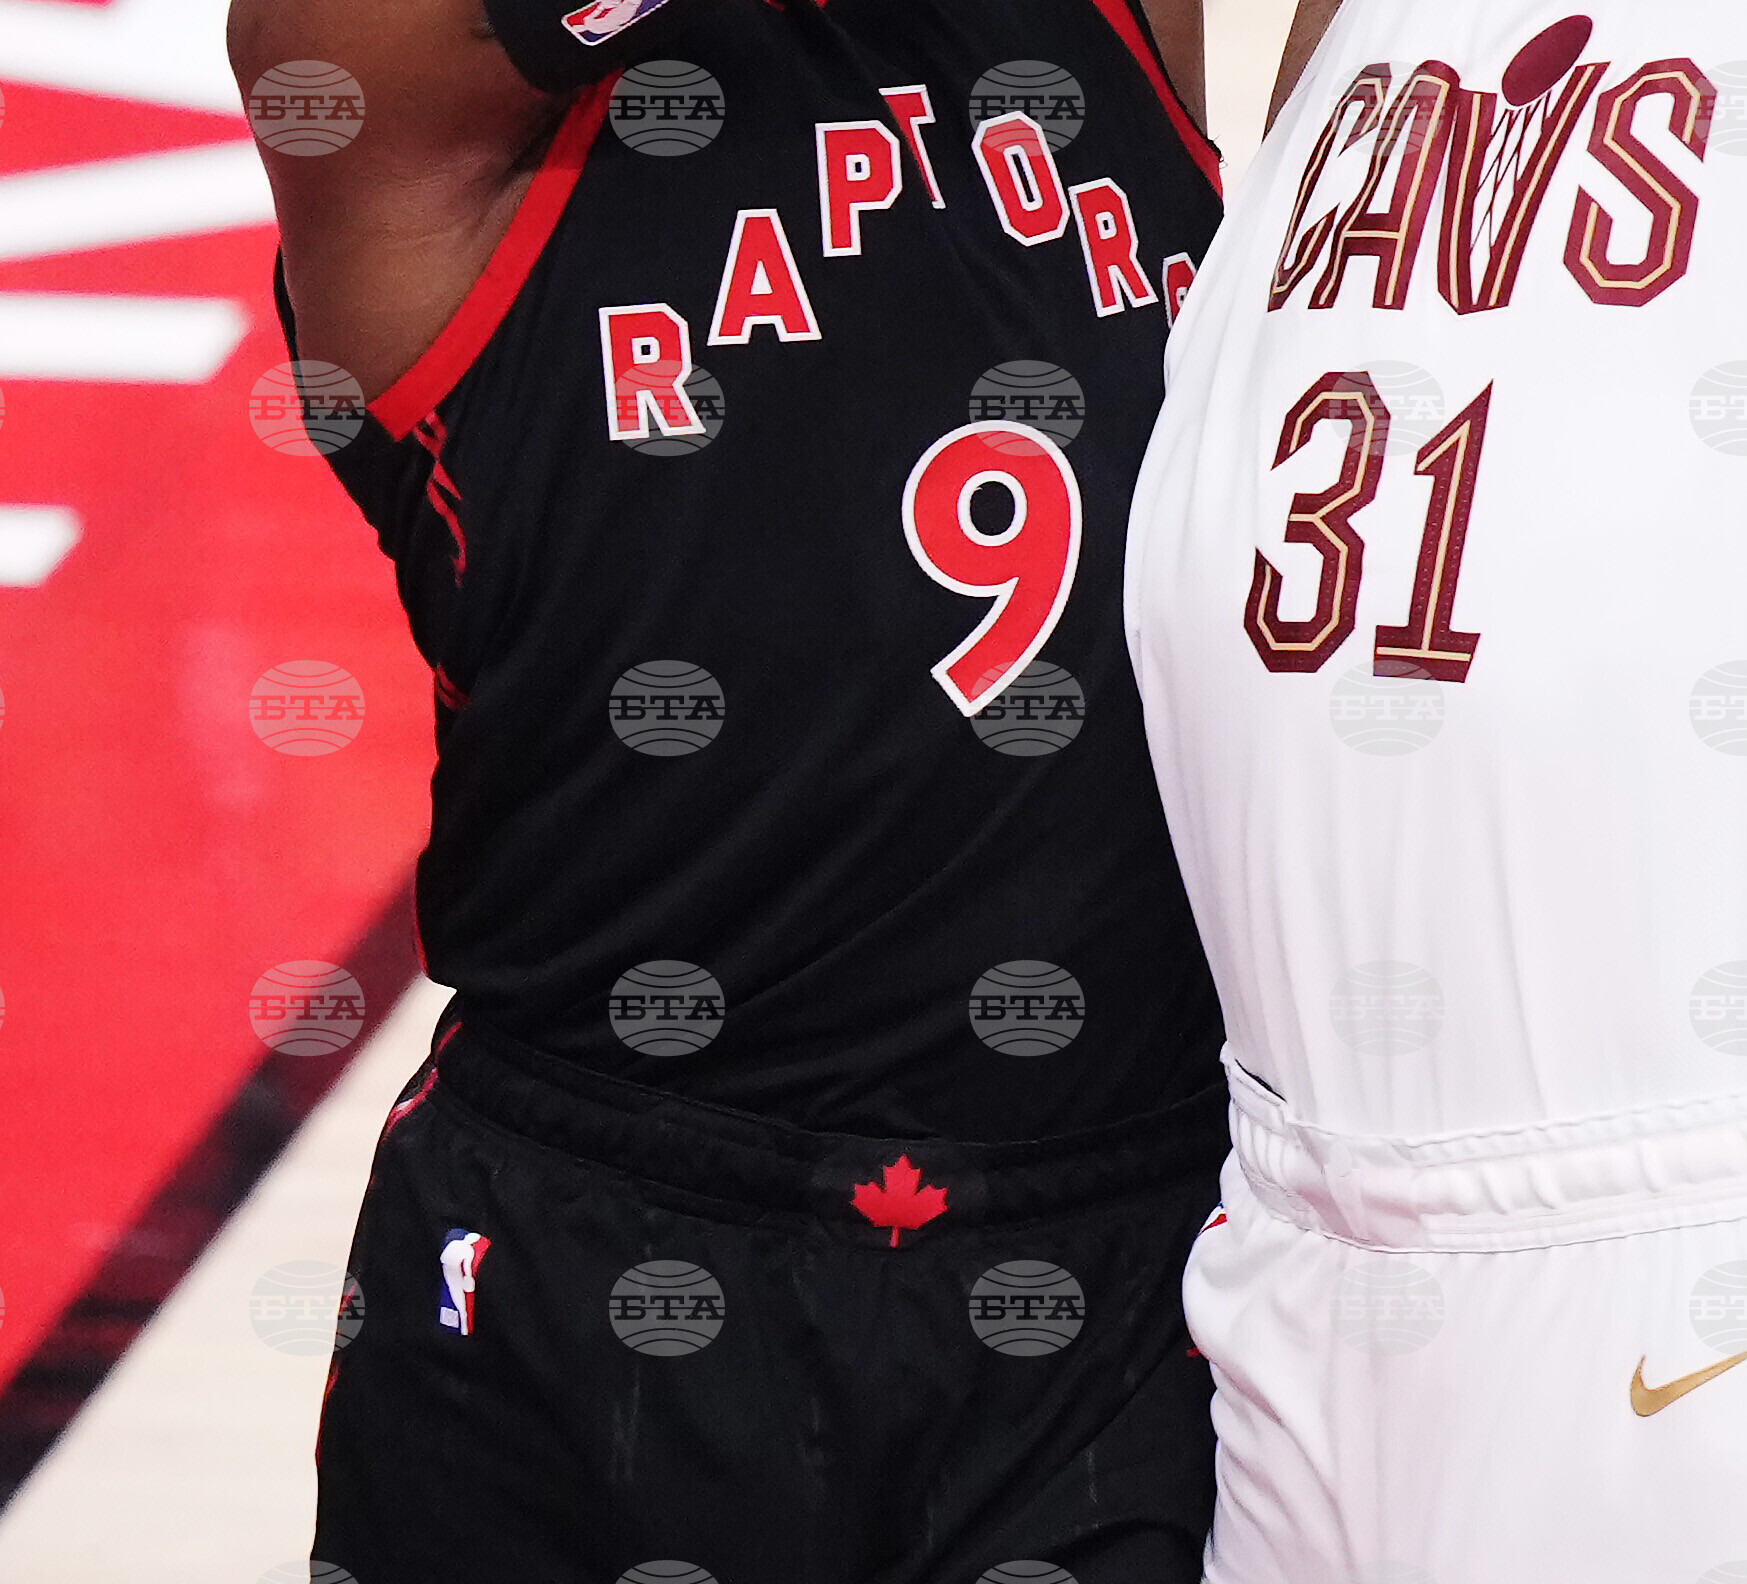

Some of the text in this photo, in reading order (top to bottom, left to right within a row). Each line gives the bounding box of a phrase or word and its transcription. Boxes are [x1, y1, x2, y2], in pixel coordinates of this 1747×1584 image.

[1266, 55, 1719, 316] CAVS
[902, 418, 1083, 718] 9
[1242, 370, 1494, 684] 31
